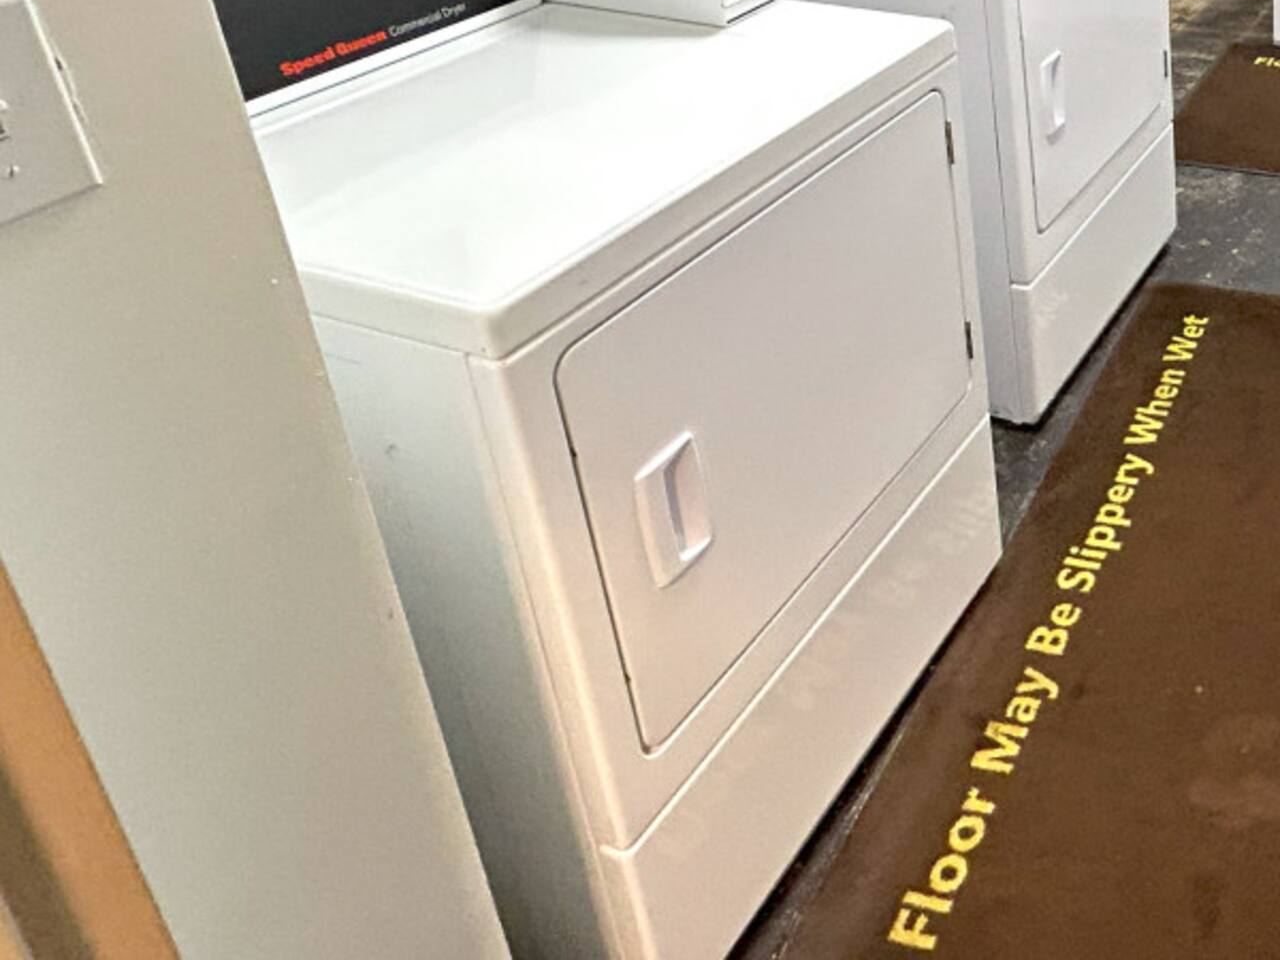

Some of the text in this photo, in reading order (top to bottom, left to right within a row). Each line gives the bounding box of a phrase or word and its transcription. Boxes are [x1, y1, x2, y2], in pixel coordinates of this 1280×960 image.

[279, 47, 336, 76] Speed
[336, 28, 388, 55] Queen
[887, 313, 1210, 951] Floor May Be Slippery When Wet
